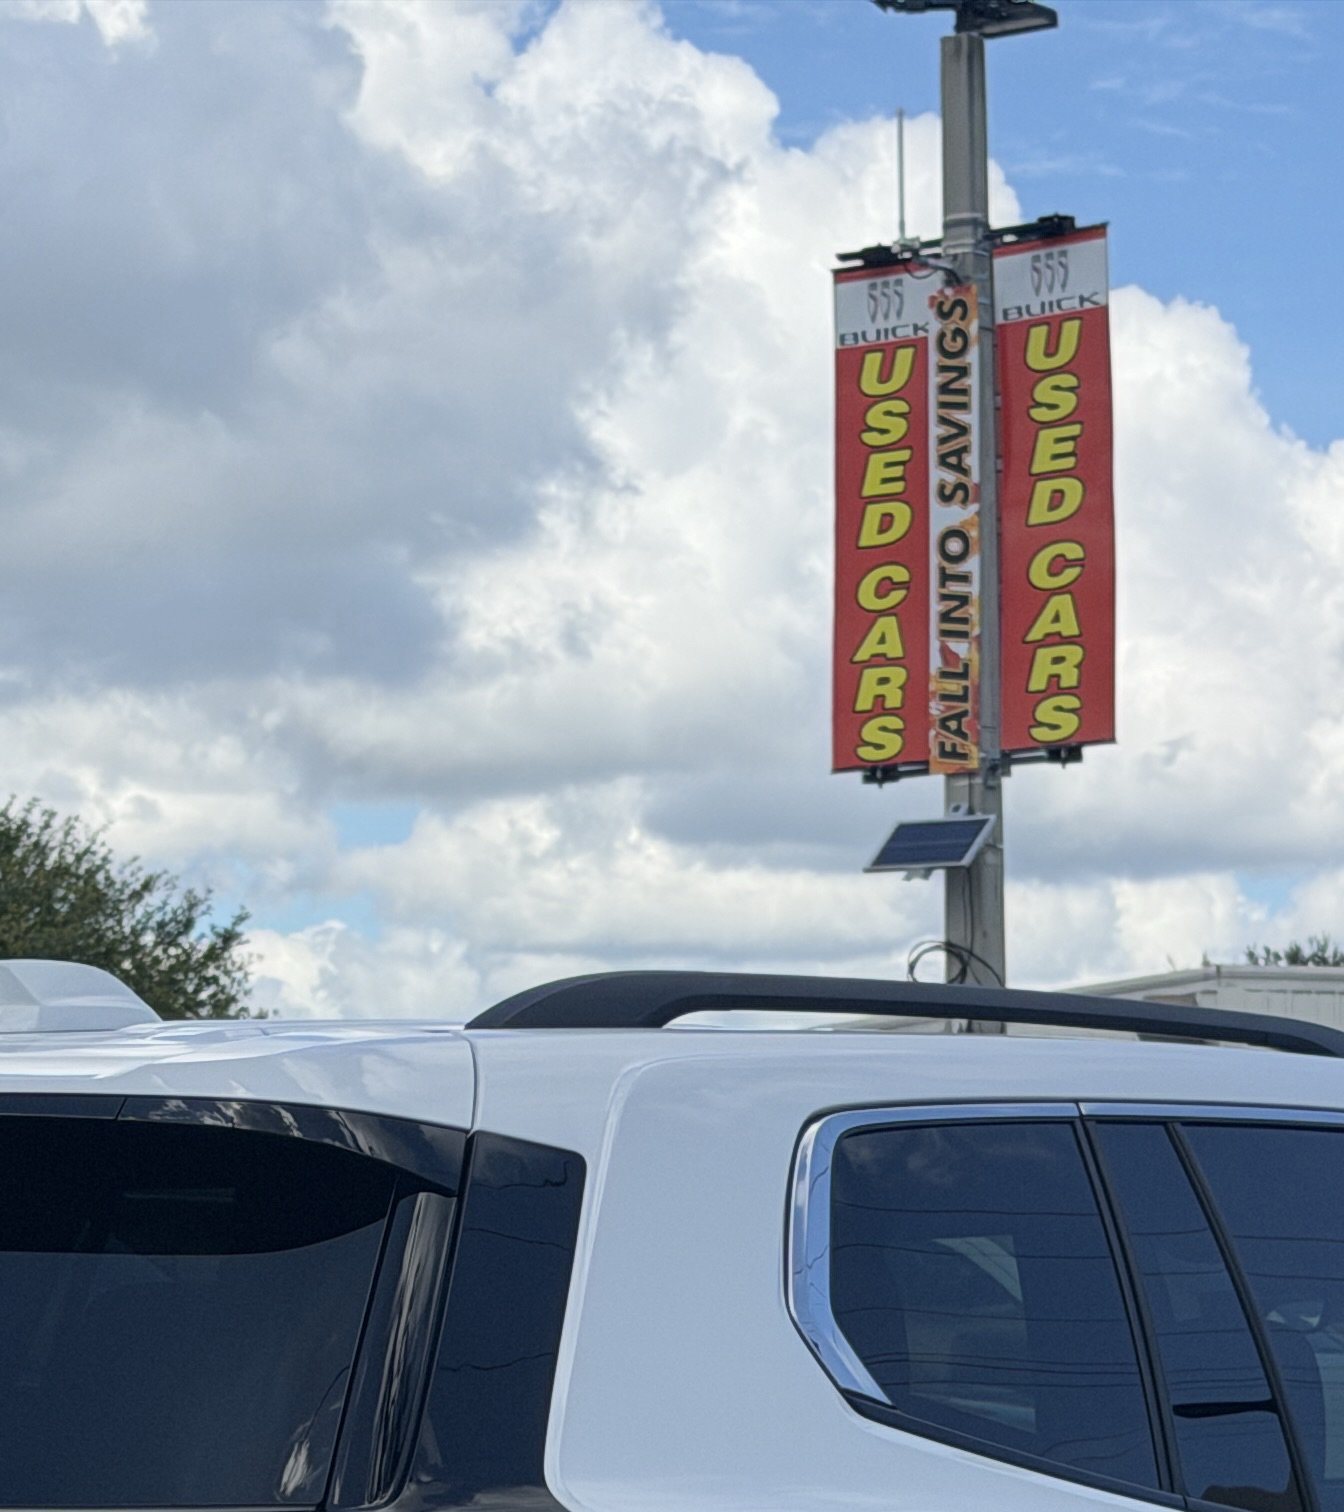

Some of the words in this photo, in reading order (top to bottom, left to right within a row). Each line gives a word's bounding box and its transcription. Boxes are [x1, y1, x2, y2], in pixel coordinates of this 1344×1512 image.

[839, 320, 929, 346] BUICK
[938, 297, 970, 506] SAVINGS
[1002, 292, 1101, 321] BUICK
[858, 346, 916, 548] USED
[1024, 317, 1084, 527] USED
[851, 563, 911, 762] CARS
[938, 528, 970, 640] INTO
[1023, 541, 1086, 743] CARS
[937, 661, 970, 761] FALL
